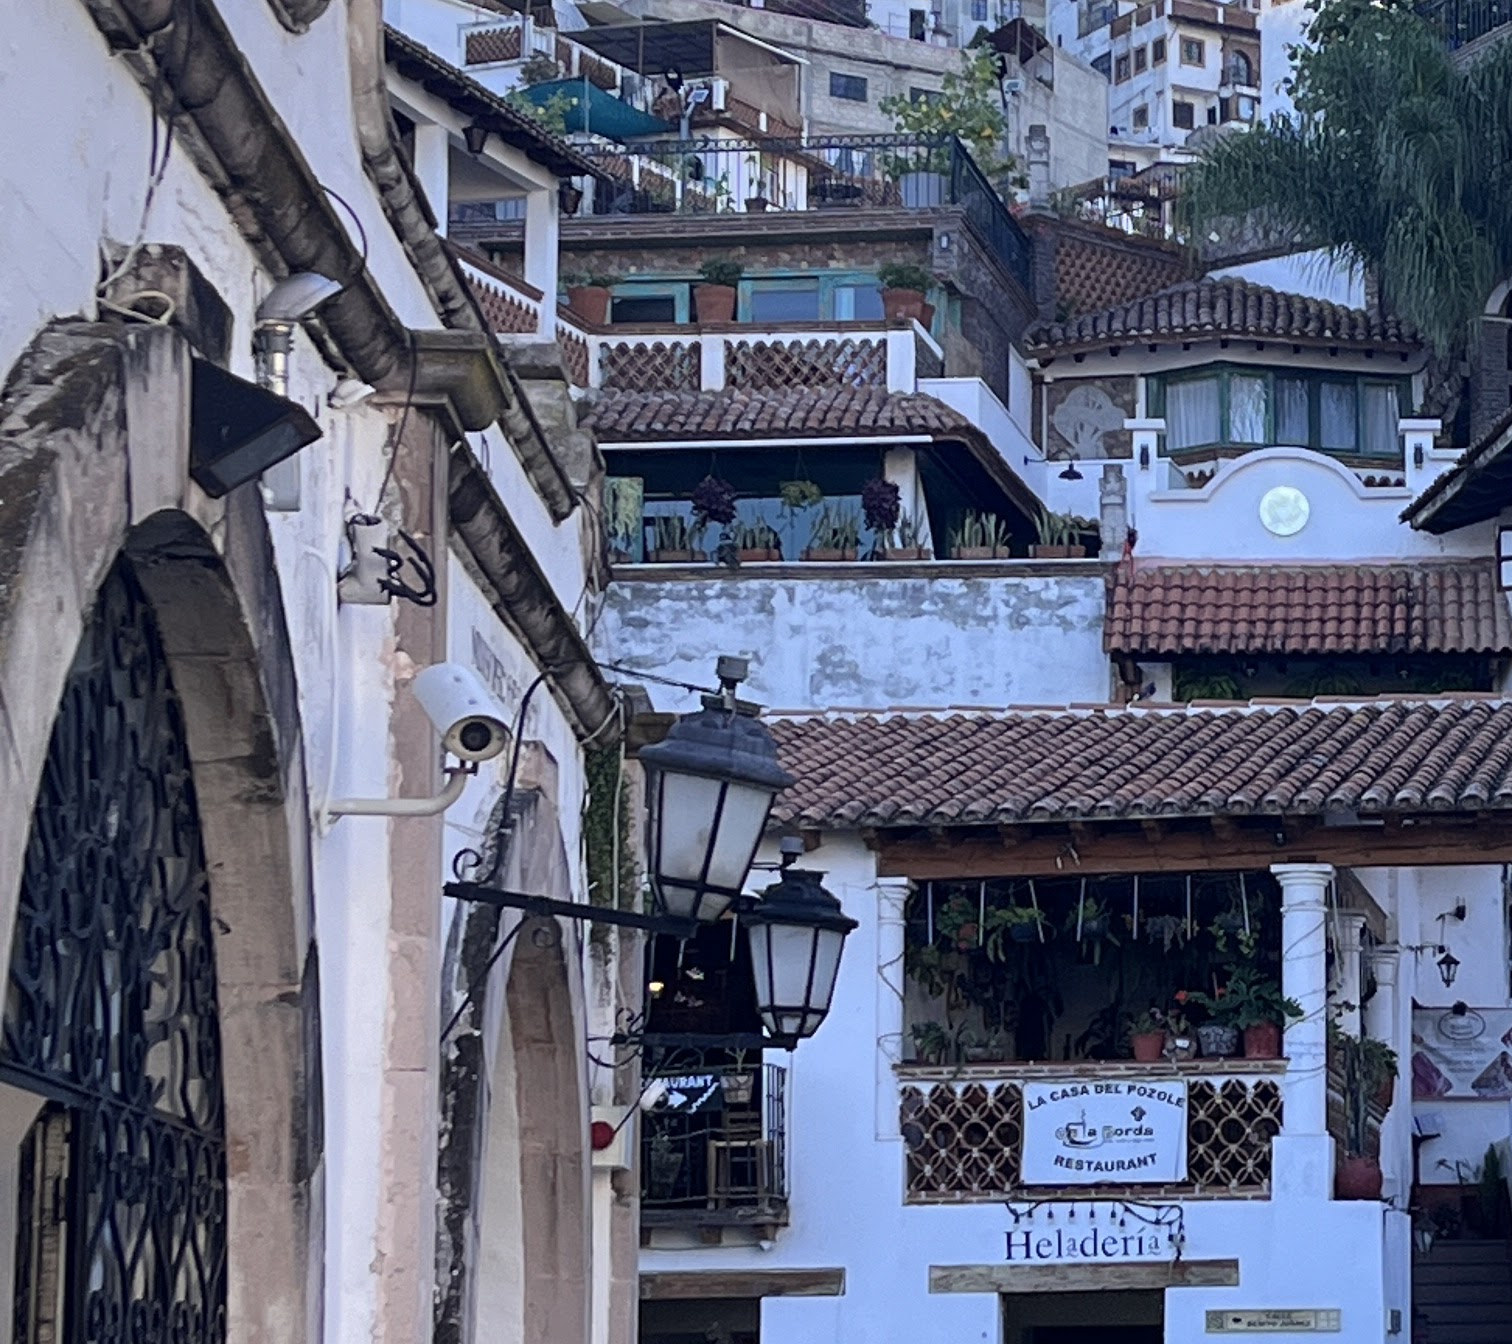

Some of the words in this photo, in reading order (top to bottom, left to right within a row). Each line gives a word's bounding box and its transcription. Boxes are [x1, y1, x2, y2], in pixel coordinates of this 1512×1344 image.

[1027, 1095, 1047, 1111] LA
[1049, 1085, 1090, 1102] CASA
[1094, 1084, 1123, 1094] DEL
[1127, 1085, 1186, 1108] POZOLE
[1053, 1153, 1158, 1173] RESTAURANT
[1004, 1226, 1163, 1260] Heladería
